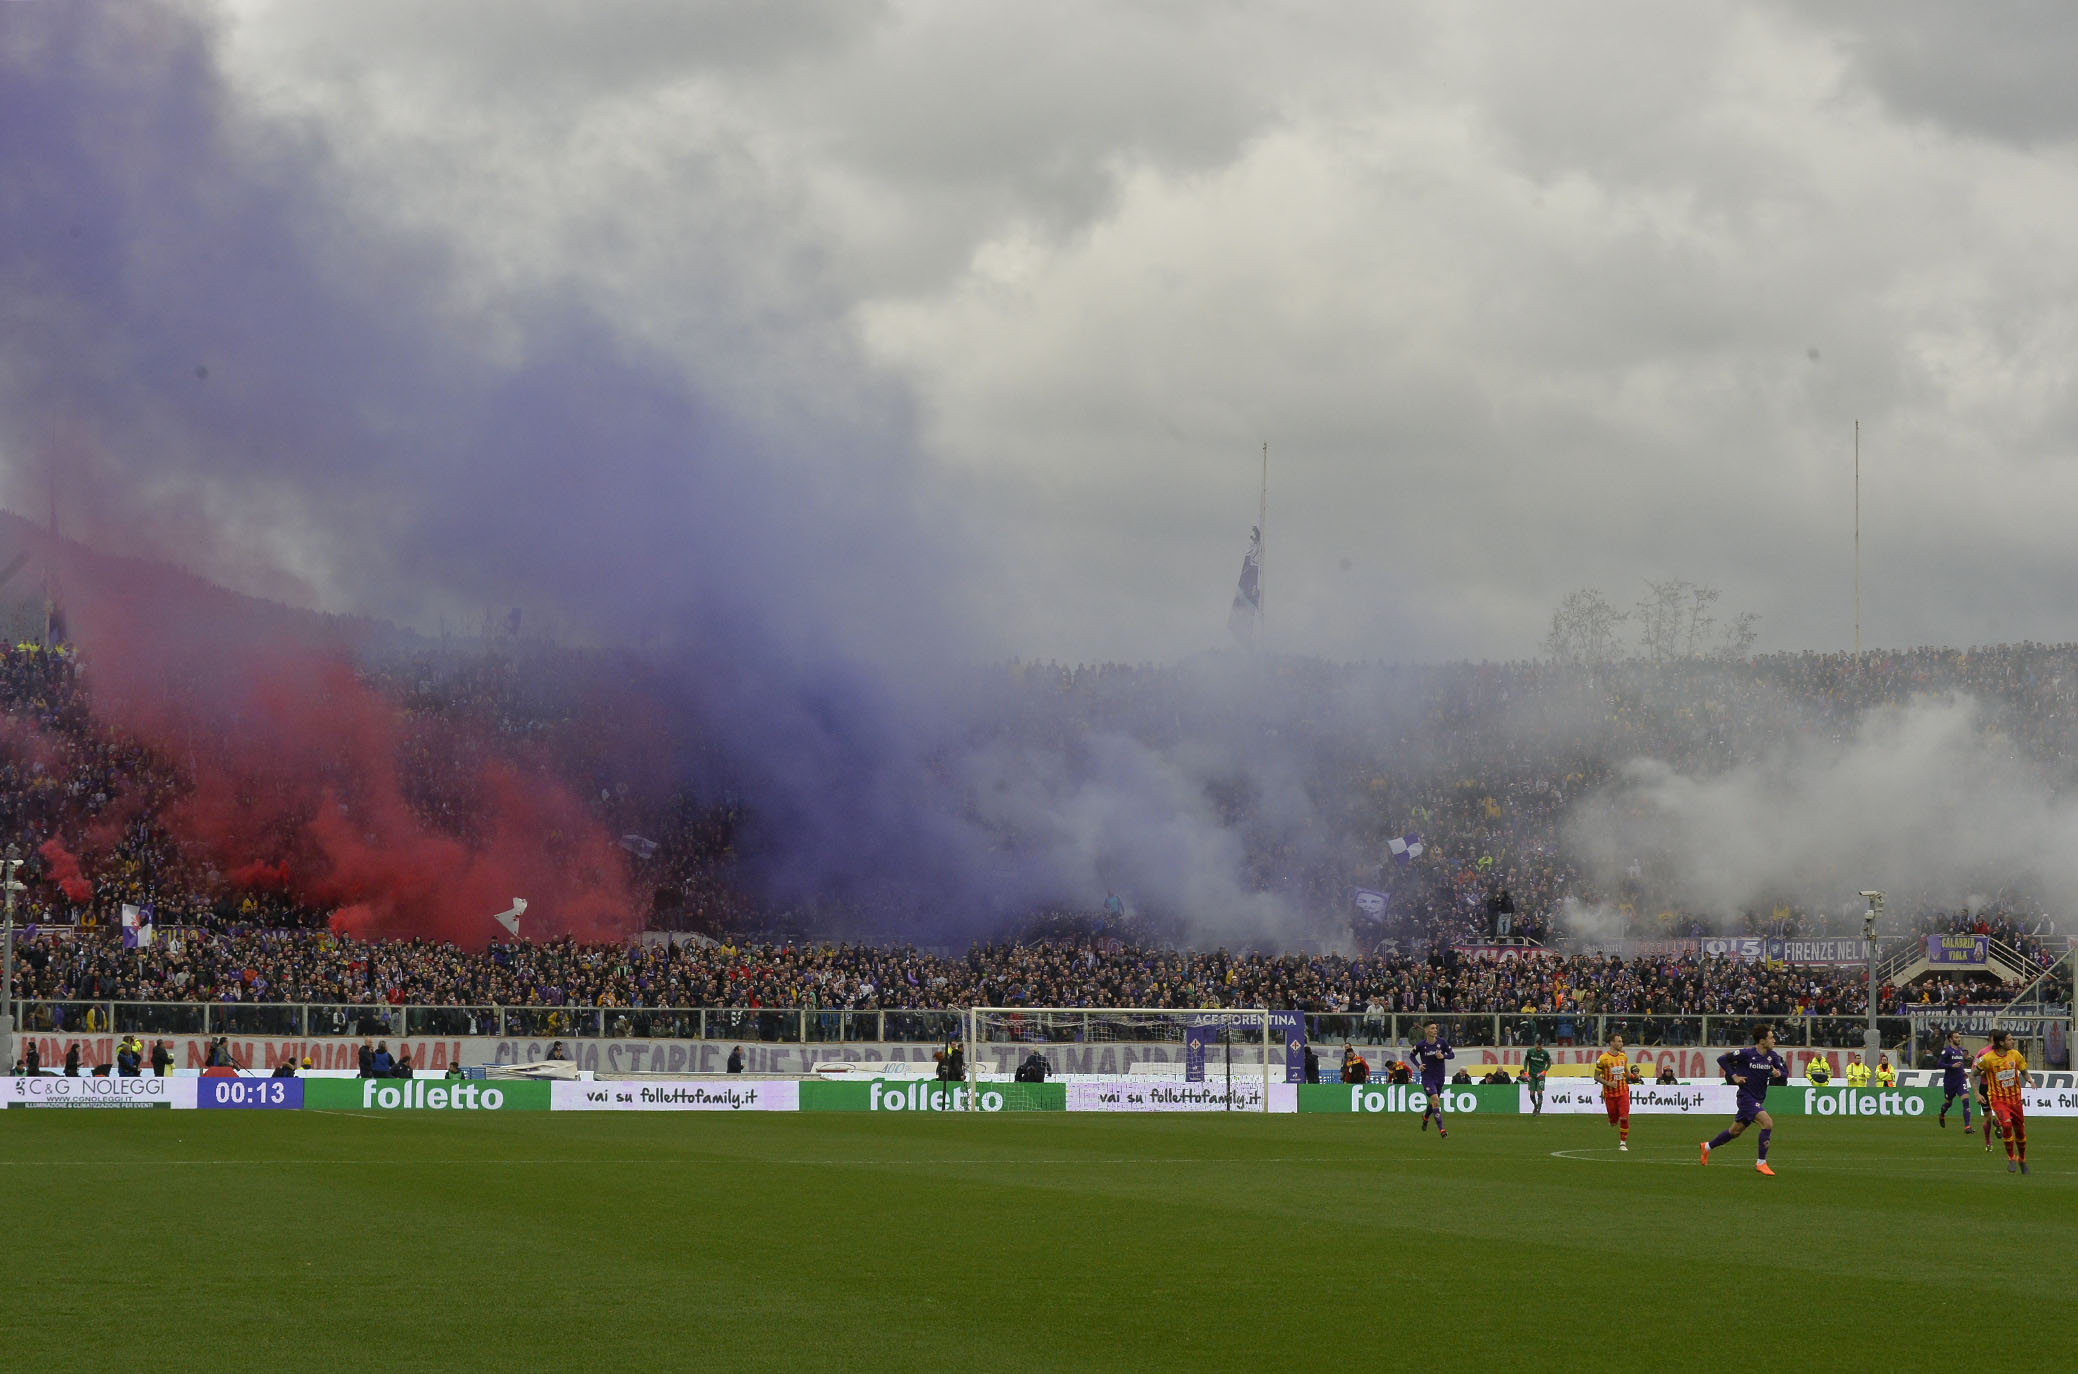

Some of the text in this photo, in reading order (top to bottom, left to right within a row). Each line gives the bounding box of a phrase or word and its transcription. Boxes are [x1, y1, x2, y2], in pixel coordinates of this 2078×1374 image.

[1784, 942, 1834, 961] FIRENZE
[1837, 941, 1859, 960] NEL
[1948, 951, 1968, 960] VIOLA
[187, 1041, 254, 1069] NN
[82, 1079, 164, 1095] NOLEGGI
[215, 1081, 285, 1104] 00:13
[363, 1079, 504, 1110] folletto
[586, 1087, 758, 1110] vai su follettofamily.it
[870, 1082, 1004, 1113] folletto
[1099, 1090, 1120, 1103] vai
[1127, 1093, 1144, 1105] su
[1351, 1084, 1478, 1113] folleto
[1551, 1091, 1571, 1104] vai
[1577, 1094, 1593, 1105] su
[1804, 1088, 1925, 1116] folletto
[2036, 1098, 2052, 1109] su
